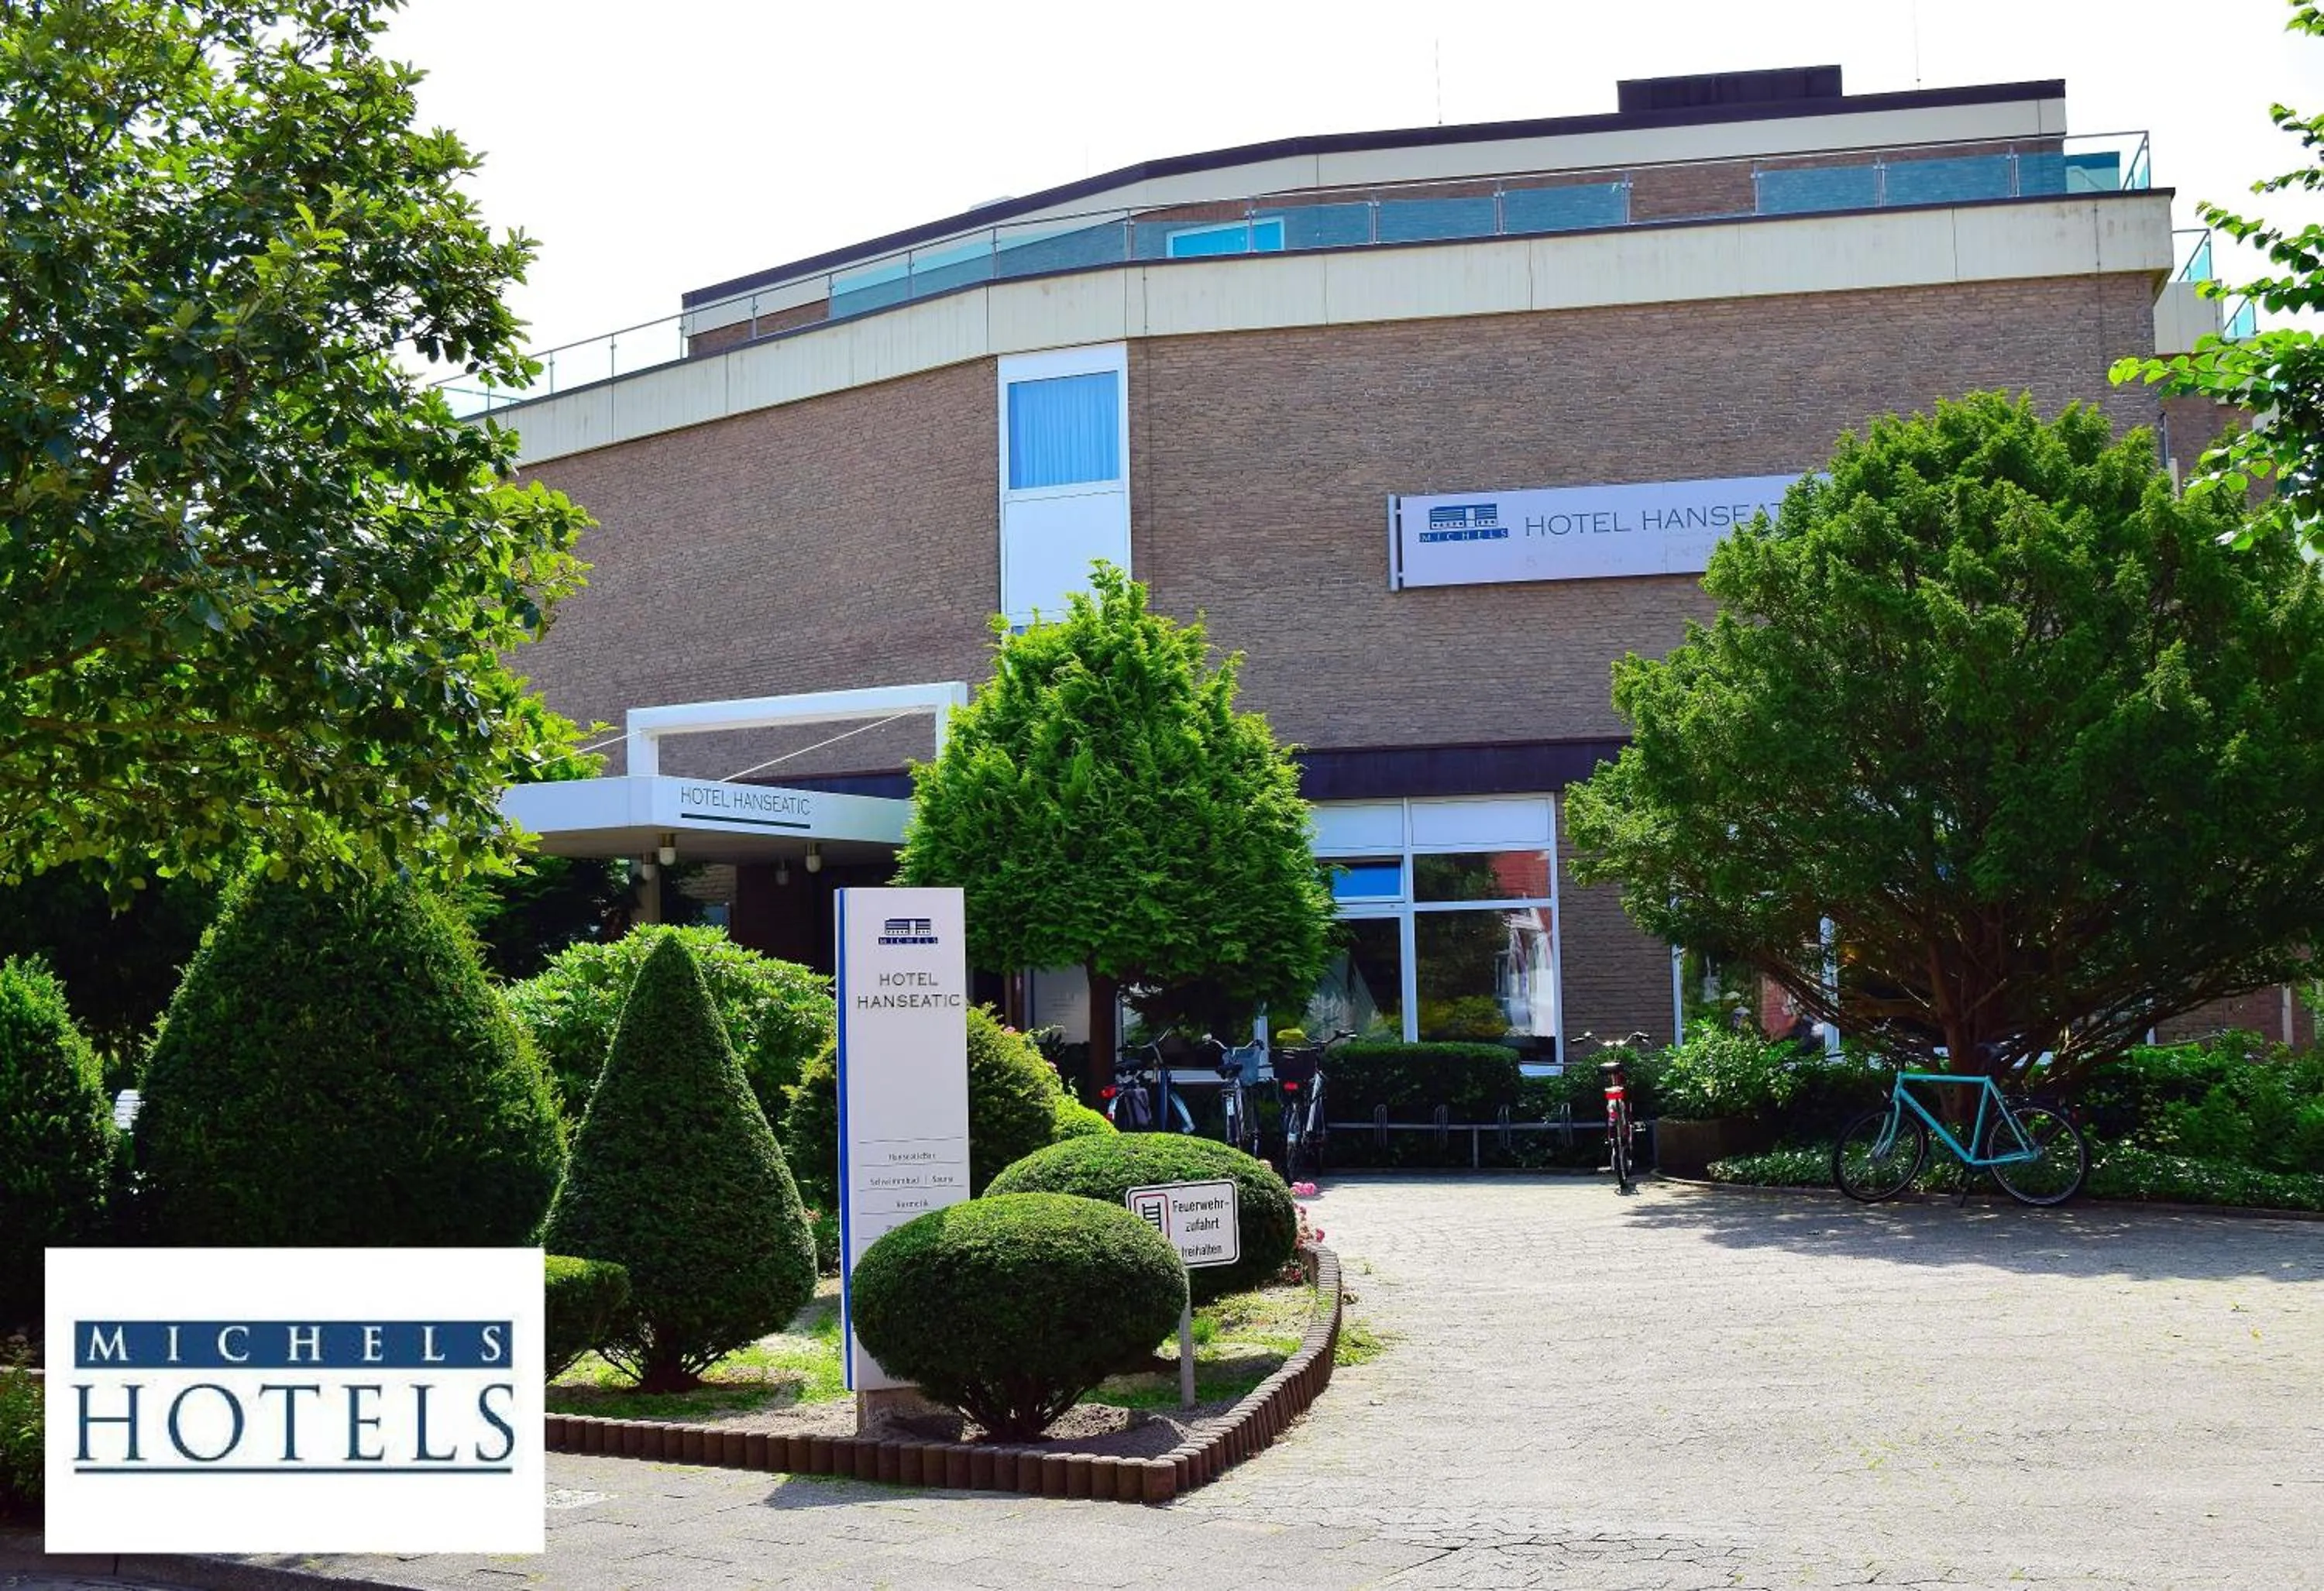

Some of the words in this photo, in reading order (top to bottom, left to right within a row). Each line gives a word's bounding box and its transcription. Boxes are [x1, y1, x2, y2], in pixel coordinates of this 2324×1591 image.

[1525, 511, 1631, 537] HOTEL
[1642, 503, 1783, 531] HANSEAT
[1420, 527, 1508, 542] MICHELS
[681, 786, 730, 808] HOTEL
[734, 792, 810, 815] HANSEATIC
[880, 972, 938, 986] HOTEL
[858, 994, 960, 1009] HANSEATIC
[1173, 1198, 1229, 1212] Feuerwehr-
[1185, 1217, 1219, 1232] zufahrt
